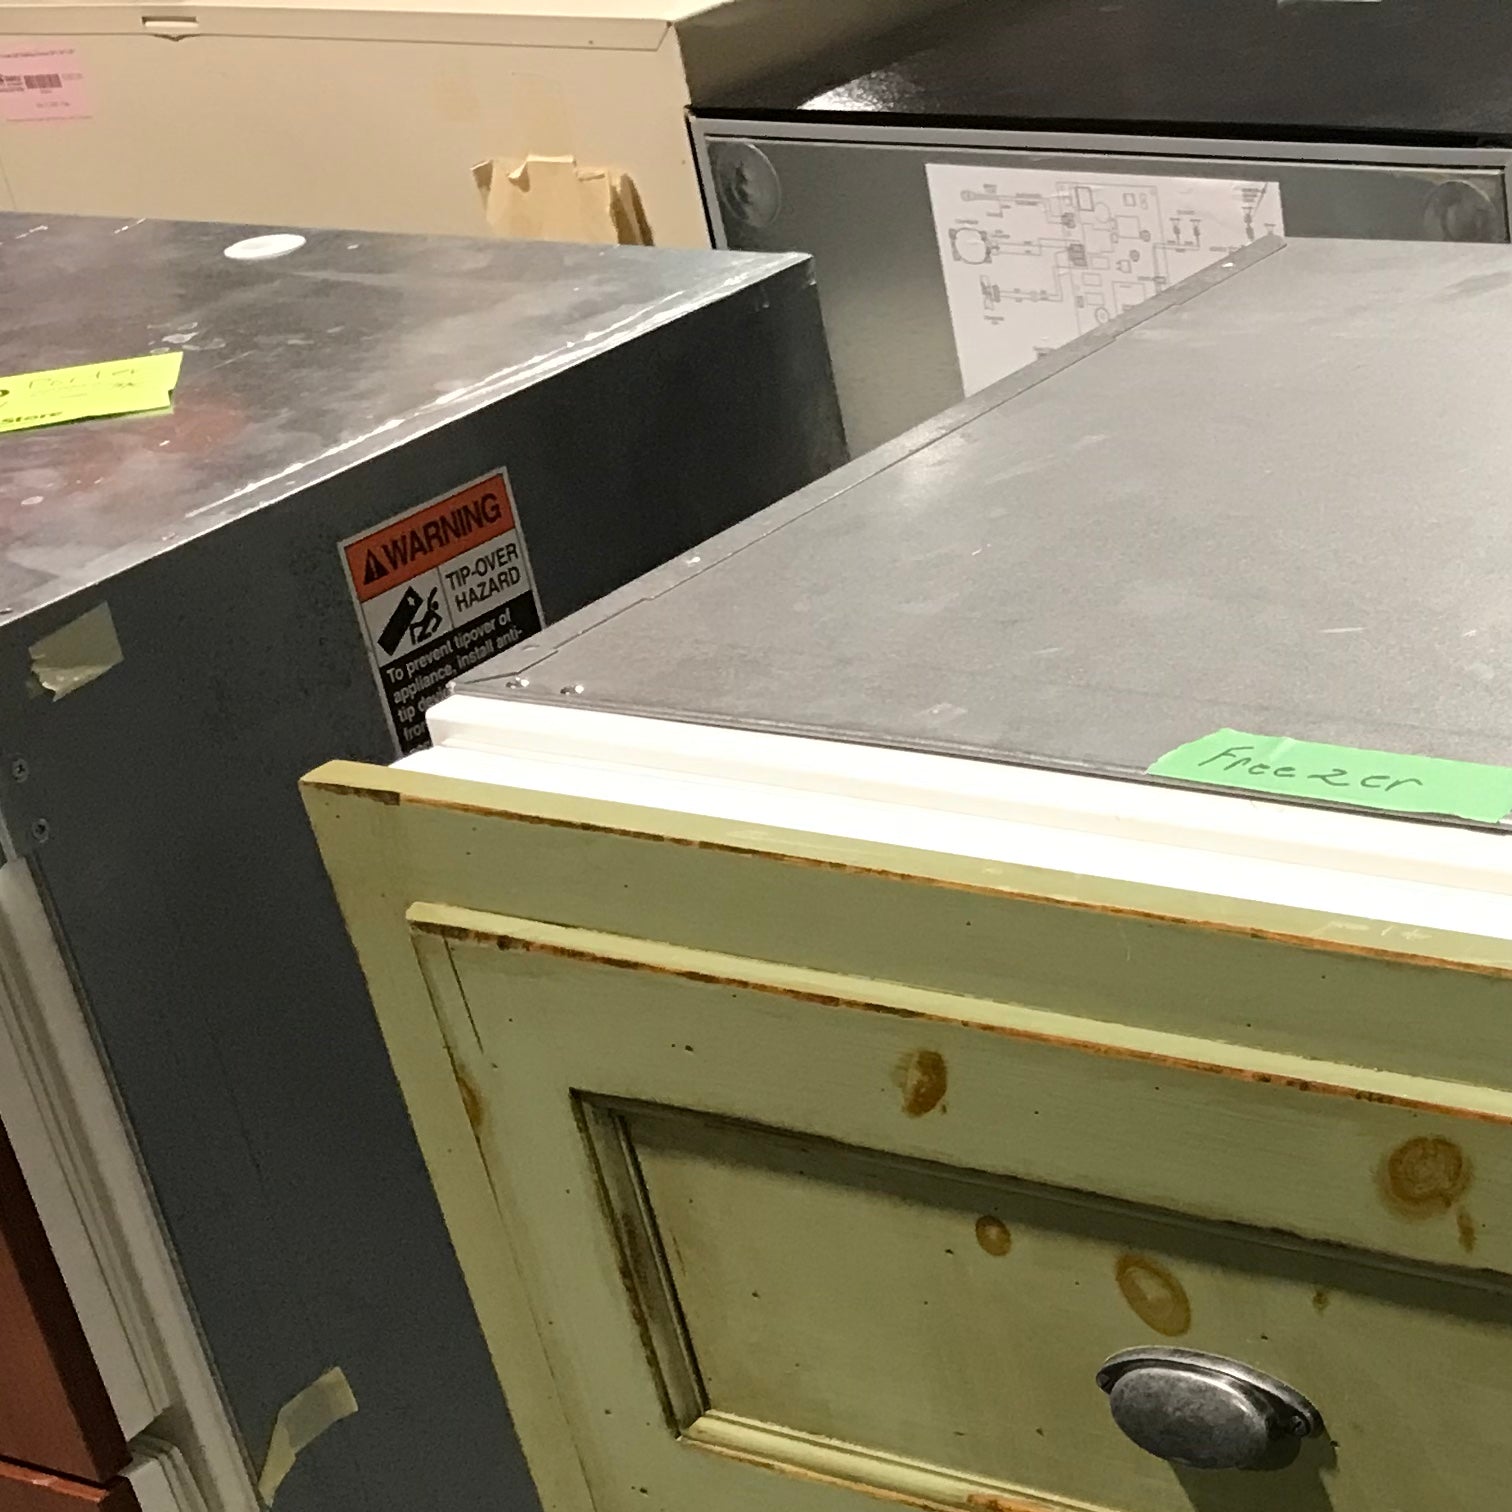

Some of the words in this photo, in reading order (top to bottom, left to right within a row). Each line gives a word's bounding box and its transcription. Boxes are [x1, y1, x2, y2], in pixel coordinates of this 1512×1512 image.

[381, 493, 501, 567] WARNING
[445, 543, 519, 591] TIP-OVER
[455, 566, 521, 612] HAZARD
[386, 667, 404, 683] To
[406, 640, 453, 678] prevent
[454, 618, 496, 650] tipover
[393, 663, 457, 704] appliance,
[457, 640, 494, 669] install
[397, 704, 416, 723] tip
